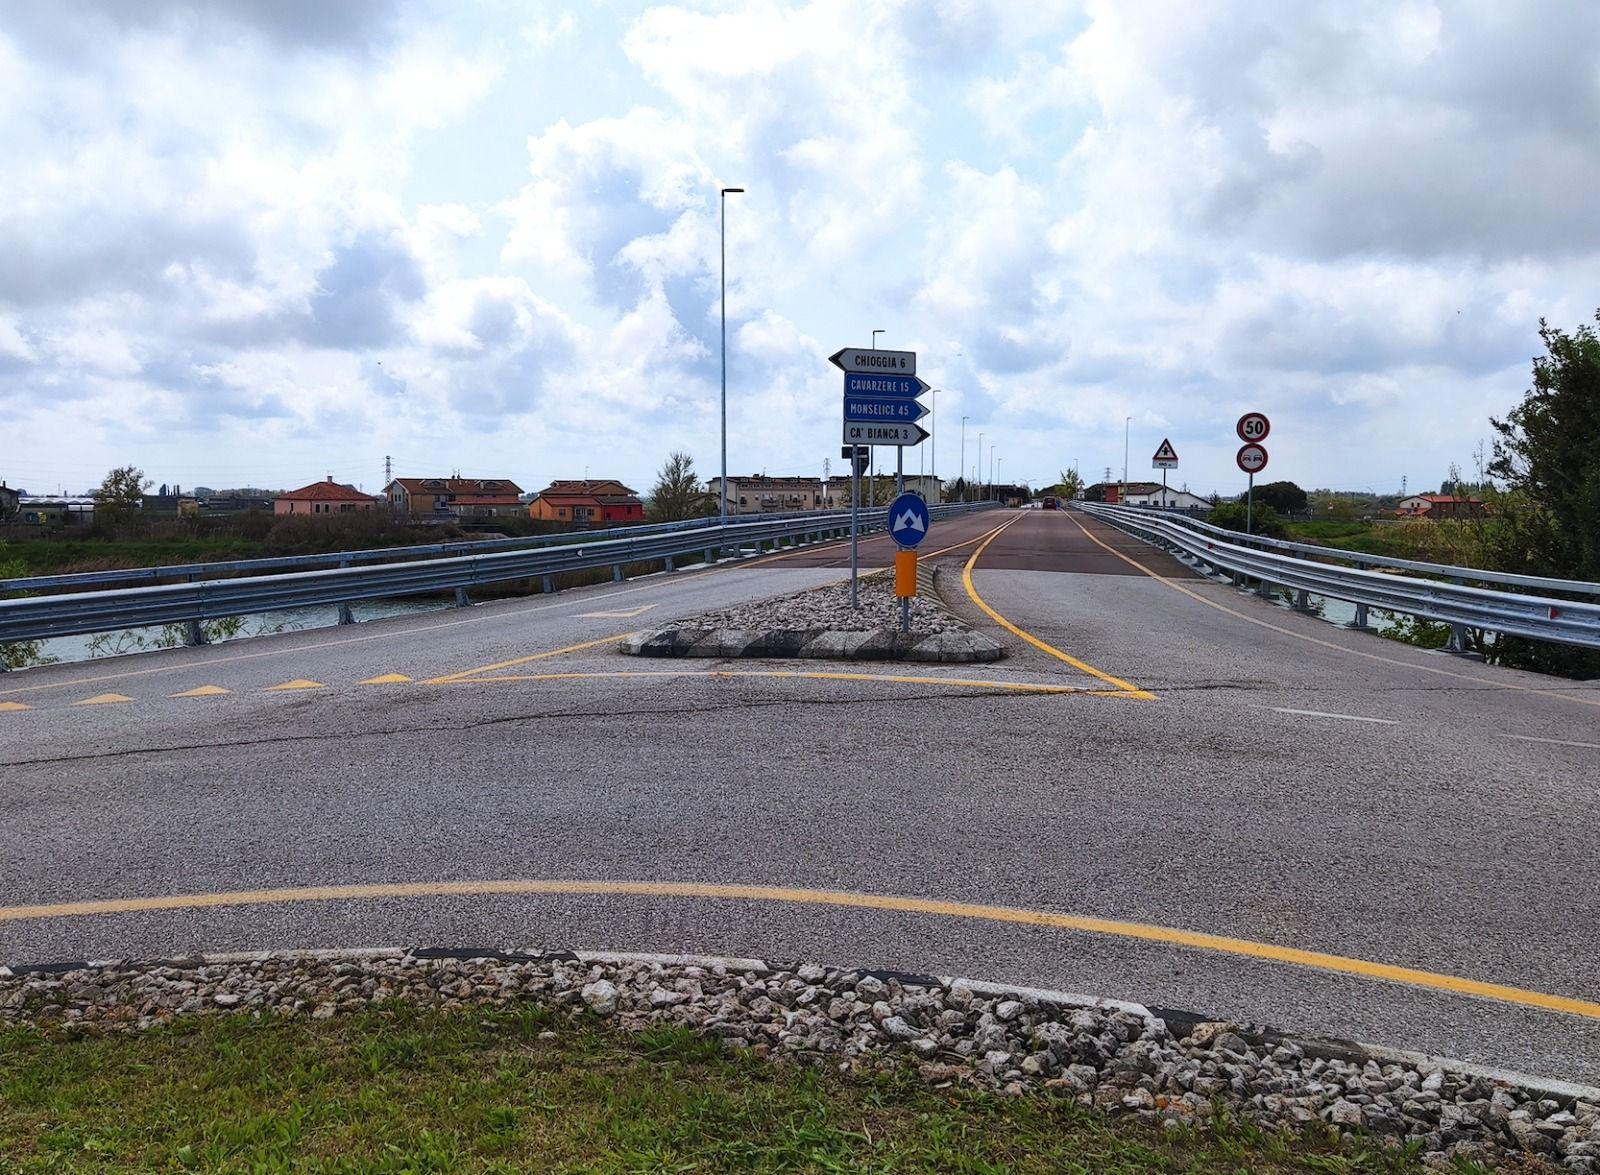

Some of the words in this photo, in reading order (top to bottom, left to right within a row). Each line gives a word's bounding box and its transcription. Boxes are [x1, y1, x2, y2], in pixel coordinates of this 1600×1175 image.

[854, 355, 897, 368] CHIOGGIA
[900, 358, 906, 368] 6
[851, 380, 897, 392] CAVARZERE
[900, 382, 909, 392] 15
[850, 403, 895, 415] MONSELICE
[898, 405, 909, 416] 45
[867, 428, 899, 439] BIANCA
[902, 429, 909, 439] 3
[1245, 421, 1264, 435] 50
